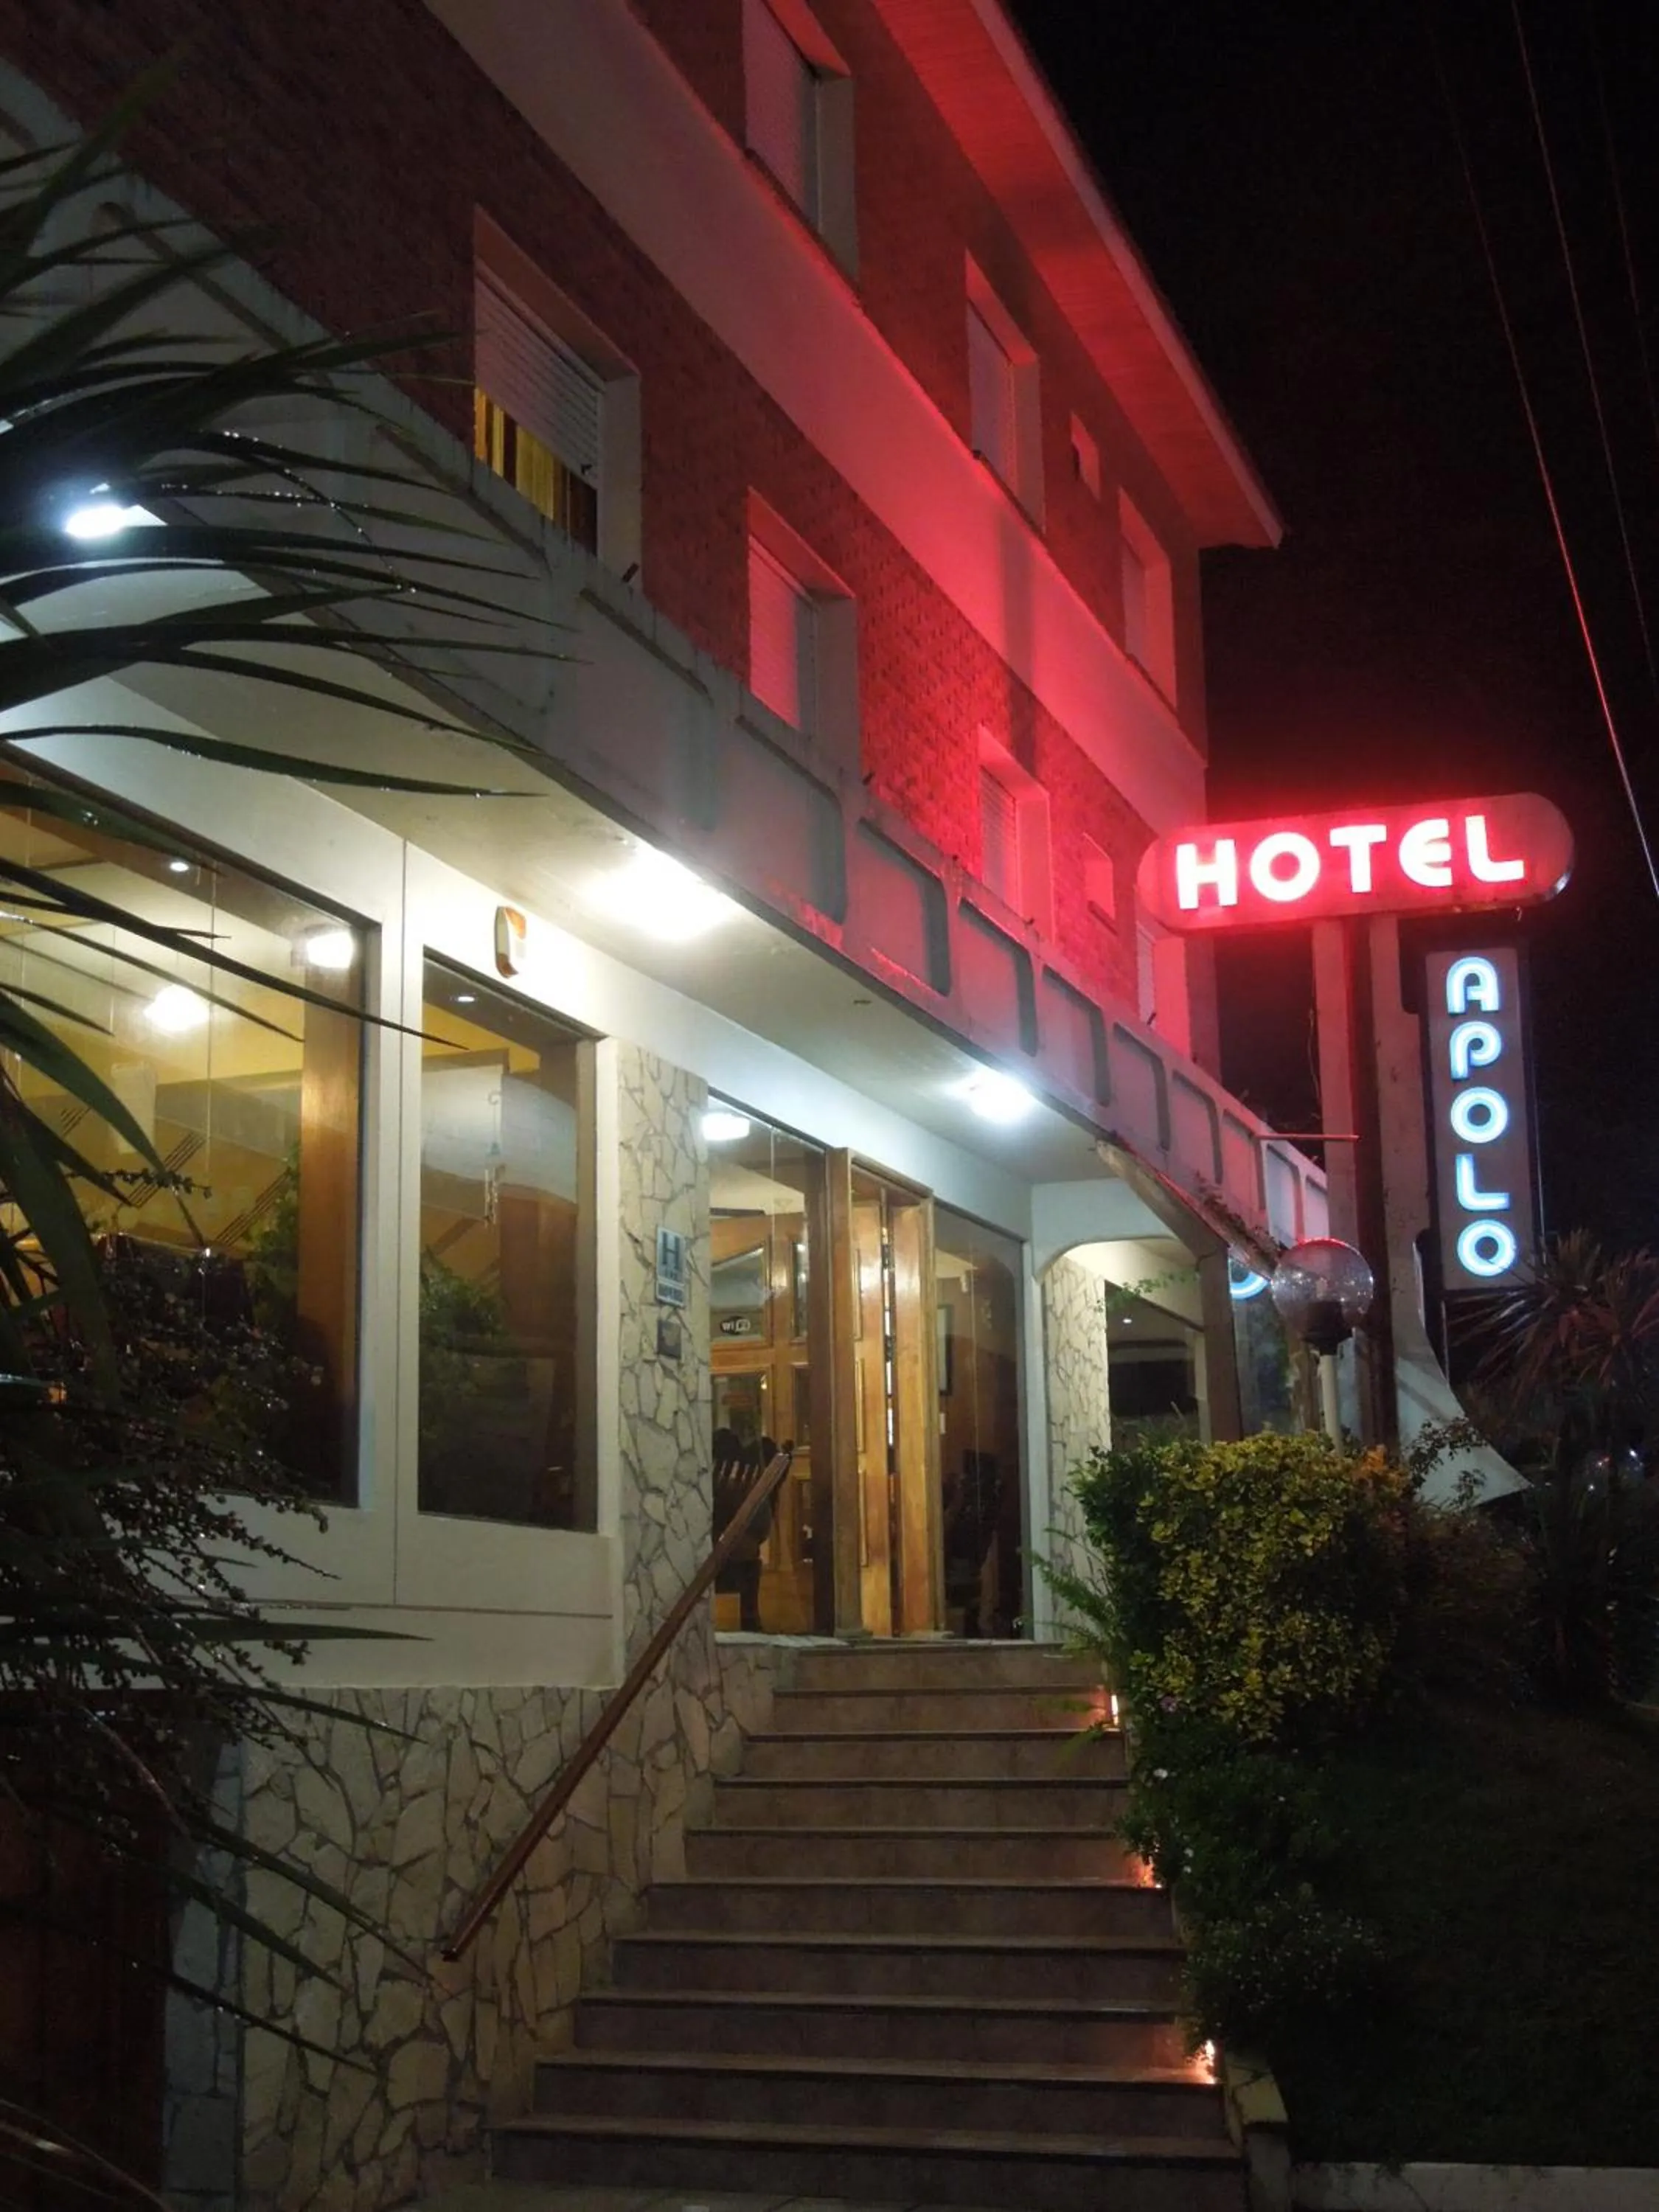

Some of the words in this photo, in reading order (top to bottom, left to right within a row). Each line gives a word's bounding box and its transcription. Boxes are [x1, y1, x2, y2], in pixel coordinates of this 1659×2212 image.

[1176, 815, 1524, 909] HOTEL
[1446, 956, 1516, 1277] APOLO
[662, 1232, 681, 1269] H
